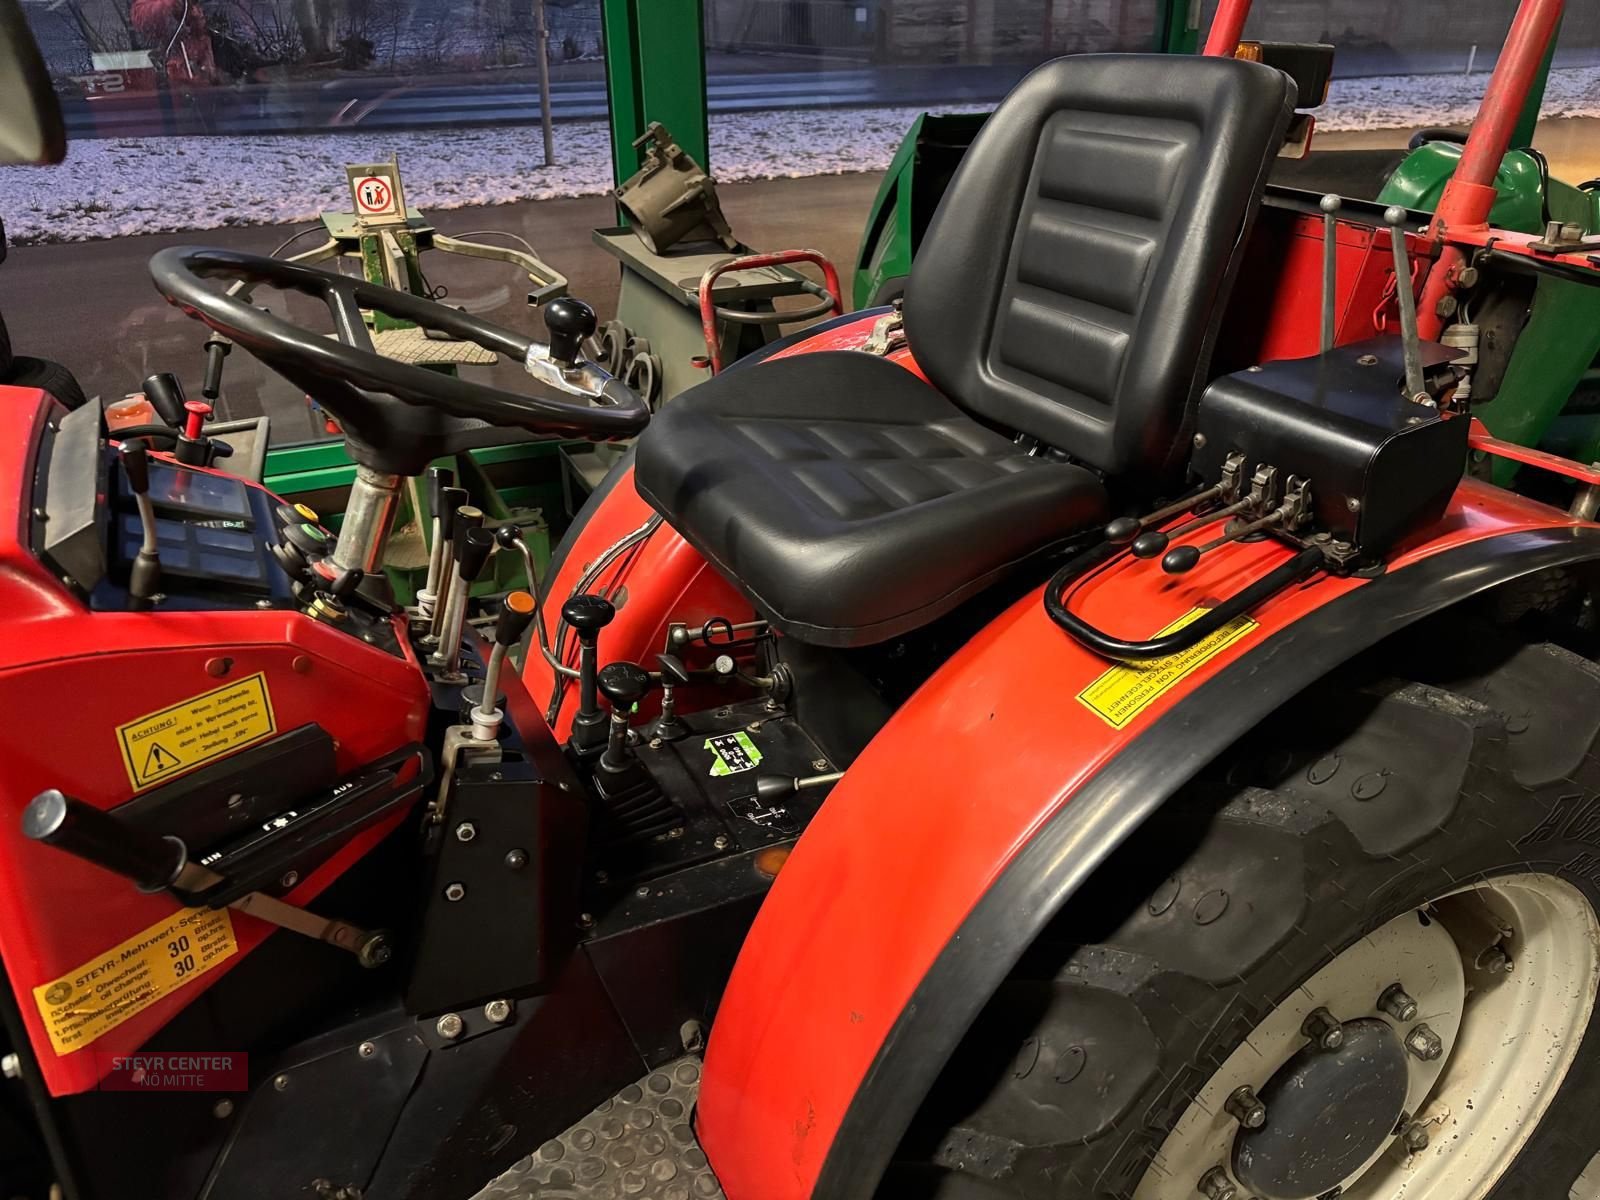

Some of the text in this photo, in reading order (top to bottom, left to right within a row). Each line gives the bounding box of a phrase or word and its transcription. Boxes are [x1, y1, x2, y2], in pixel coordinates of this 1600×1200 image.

[1230, 620, 1244, 631] DIE
[1155, 669, 1174, 685] VON
[1114, 685, 1154, 718] PERSONEN
[332, 782, 353, 796] AUS
[200, 851, 223, 866] EIN
[167, 935, 190, 958] 30
[173, 954, 195, 977] 30
[100, 989, 112, 1001] oil
[61, 1030, 82, 1045] first
